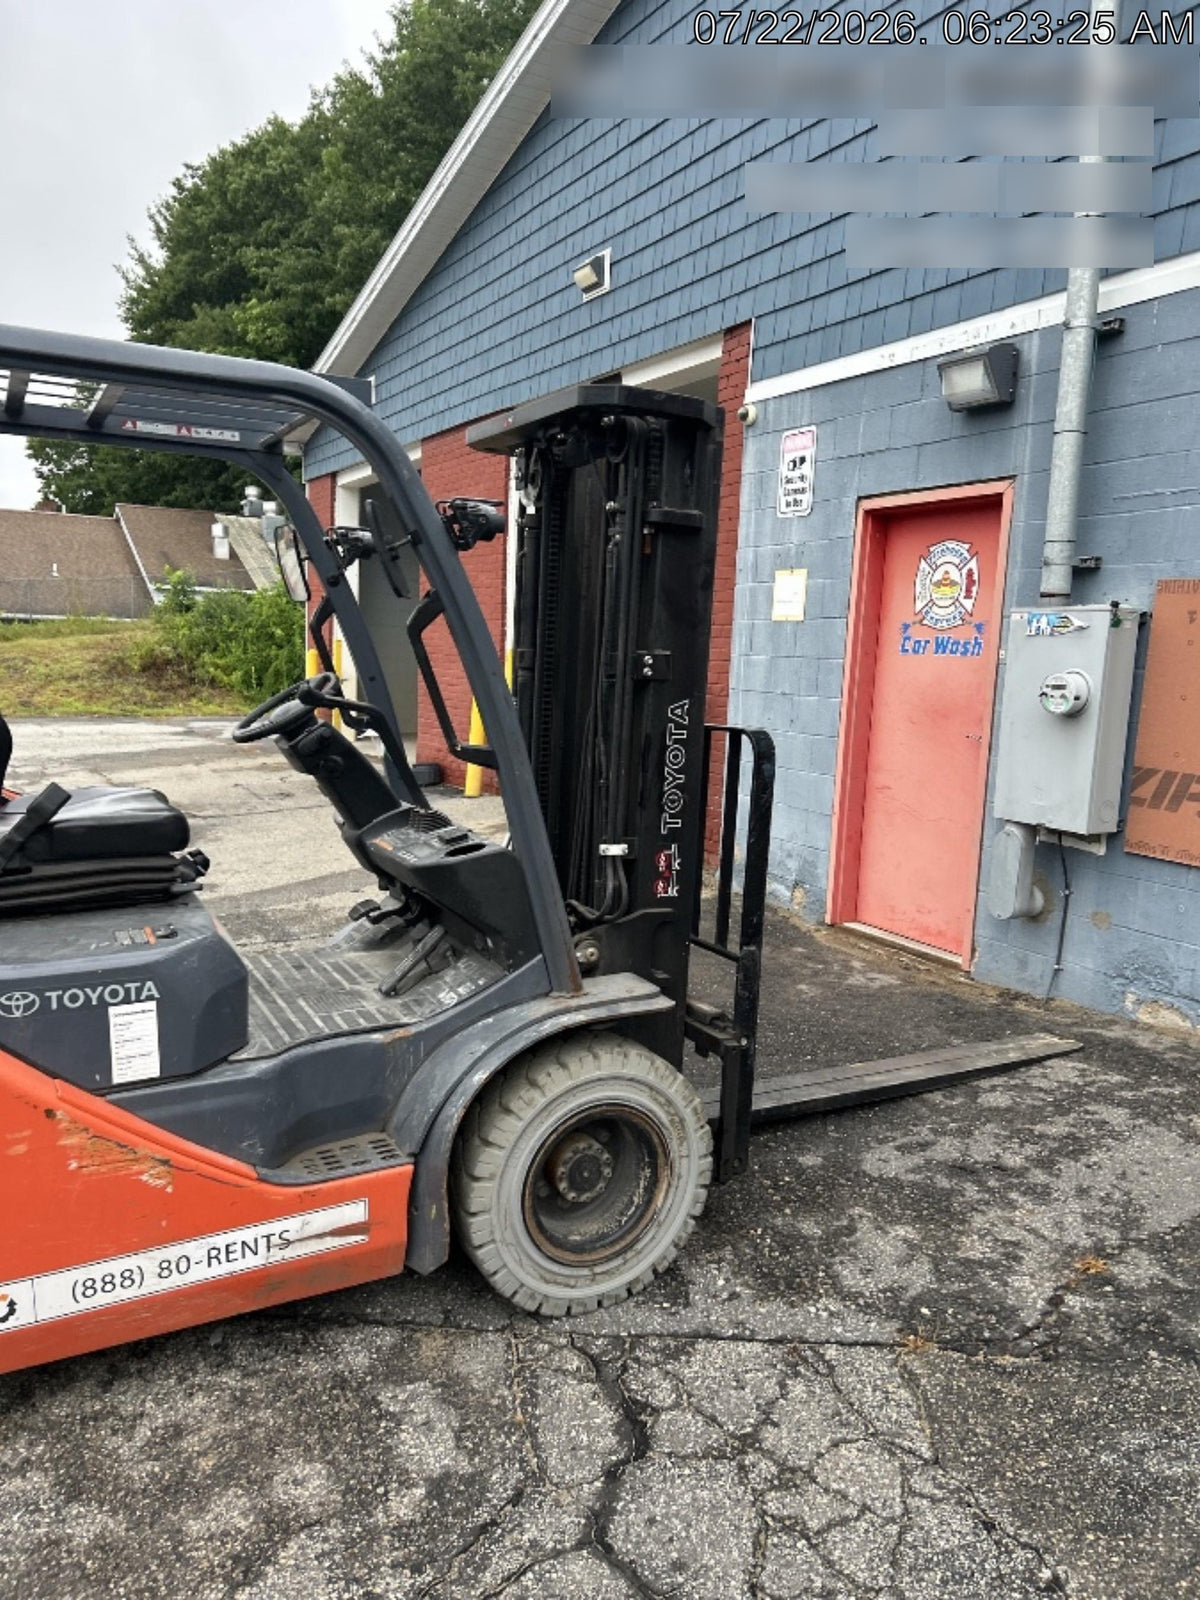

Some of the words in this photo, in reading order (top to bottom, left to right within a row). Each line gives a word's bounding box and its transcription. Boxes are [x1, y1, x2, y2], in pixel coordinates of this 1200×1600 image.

[900, 635, 930, 656] Car
[933, 635, 983, 657] Wash
[661, 699, 689, 835] TOYOTA
[45, 980, 160, 1011] TOYOTA
[71, 1265, 146, 1304] (888)
[156, 1229, 292, 1280] 80-RENTS
